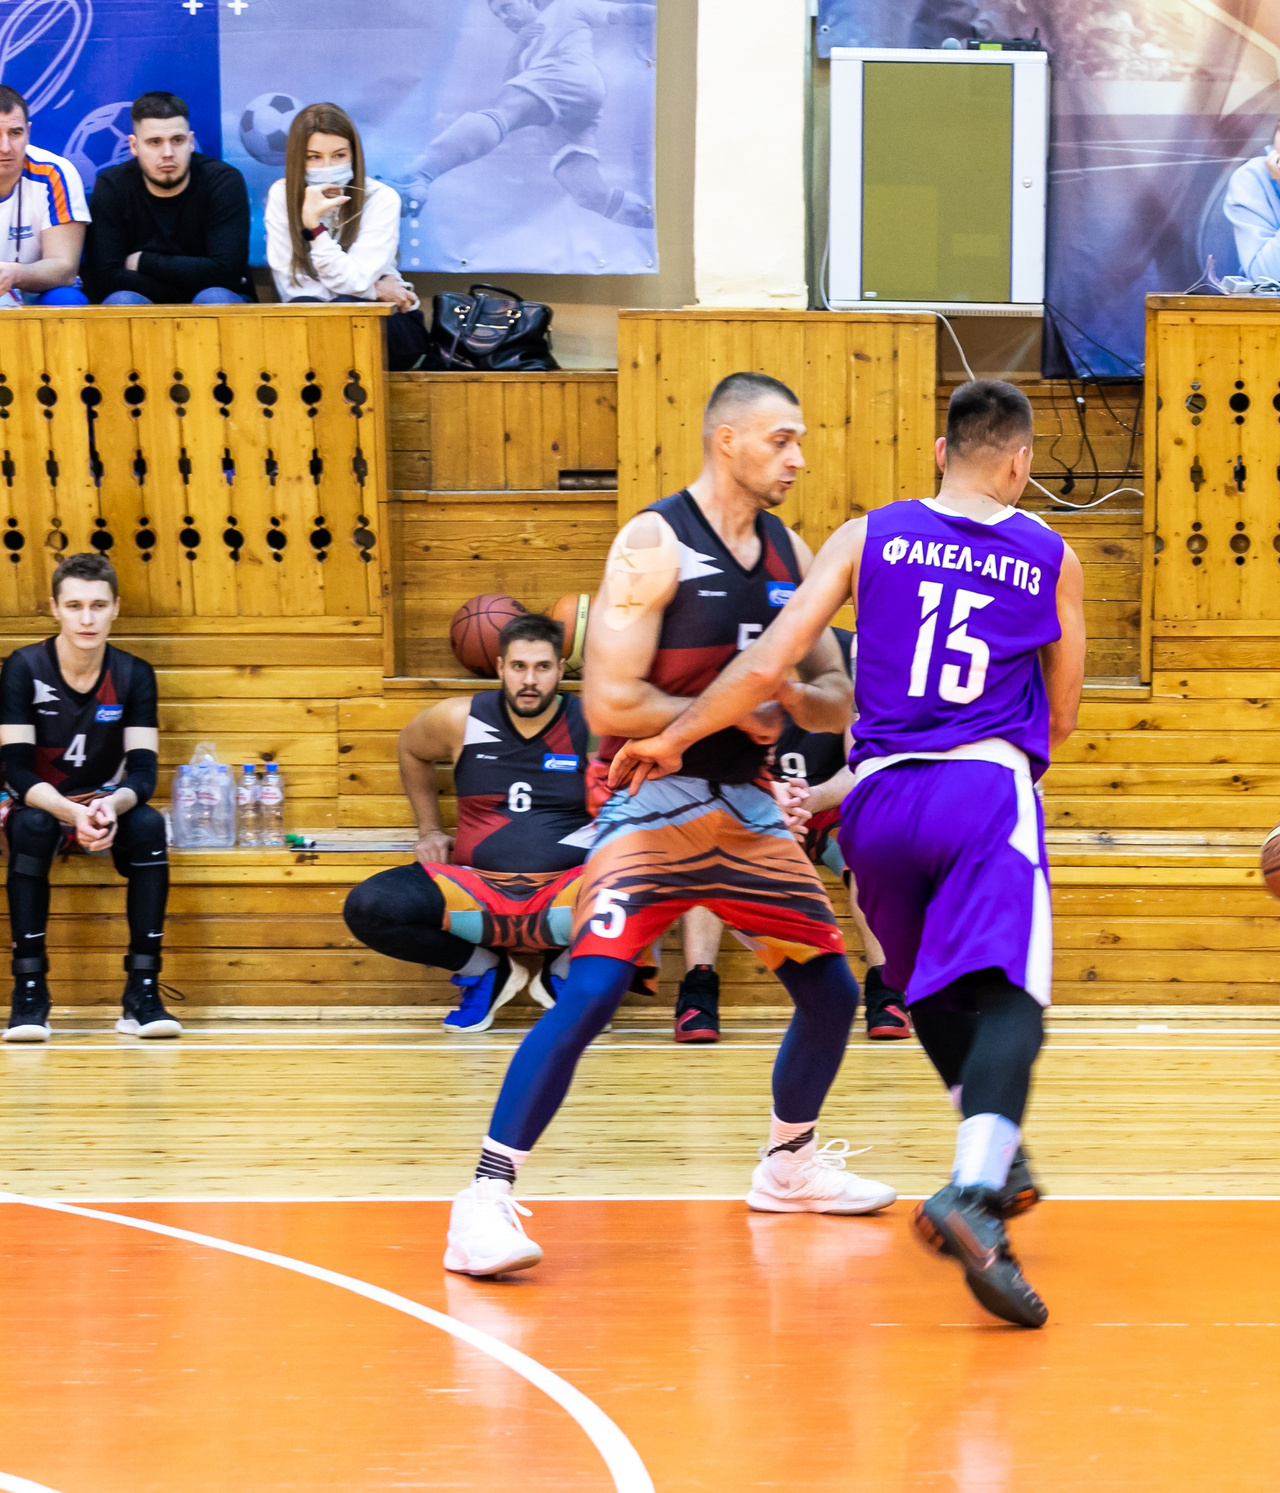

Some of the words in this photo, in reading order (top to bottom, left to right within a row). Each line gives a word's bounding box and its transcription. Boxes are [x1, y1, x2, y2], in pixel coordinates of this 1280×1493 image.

[882, 535, 1042, 596] ФАКЕЛ-АГПЗ
[907, 580, 995, 705] 15
[63, 733, 87, 767] 4
[780, 752, 807, 778] 9
[508, 781, 533, 813] 6
[590, 888, 631, 939] 5
